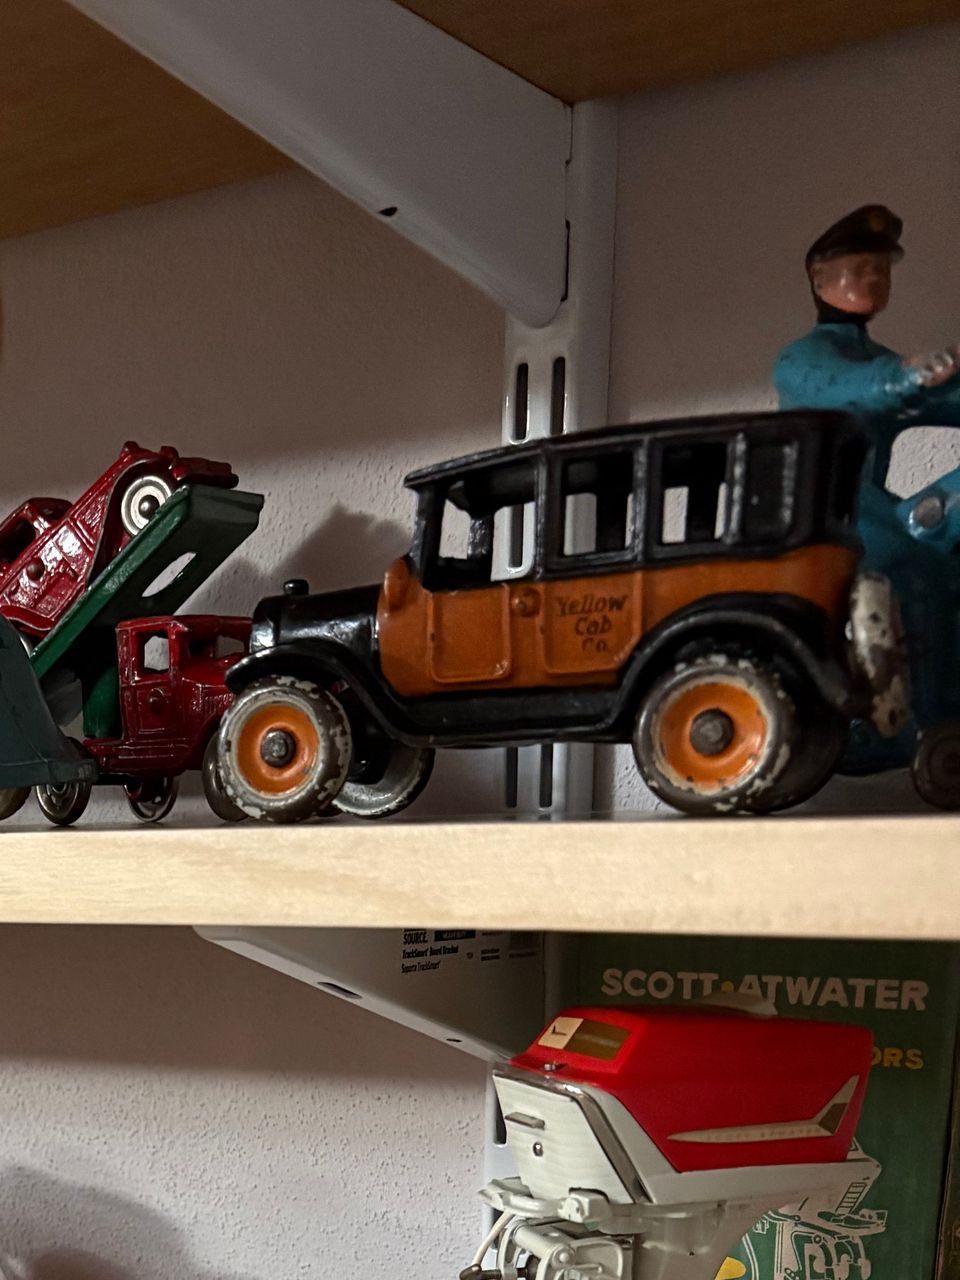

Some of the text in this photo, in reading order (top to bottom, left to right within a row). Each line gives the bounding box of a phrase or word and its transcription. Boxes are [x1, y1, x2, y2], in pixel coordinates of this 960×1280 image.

[556, 594, 629, 617] Yellow
[575, 614, 613, 636] Cab
[601, 968, 930, 1011] SCOTT ATWATER
